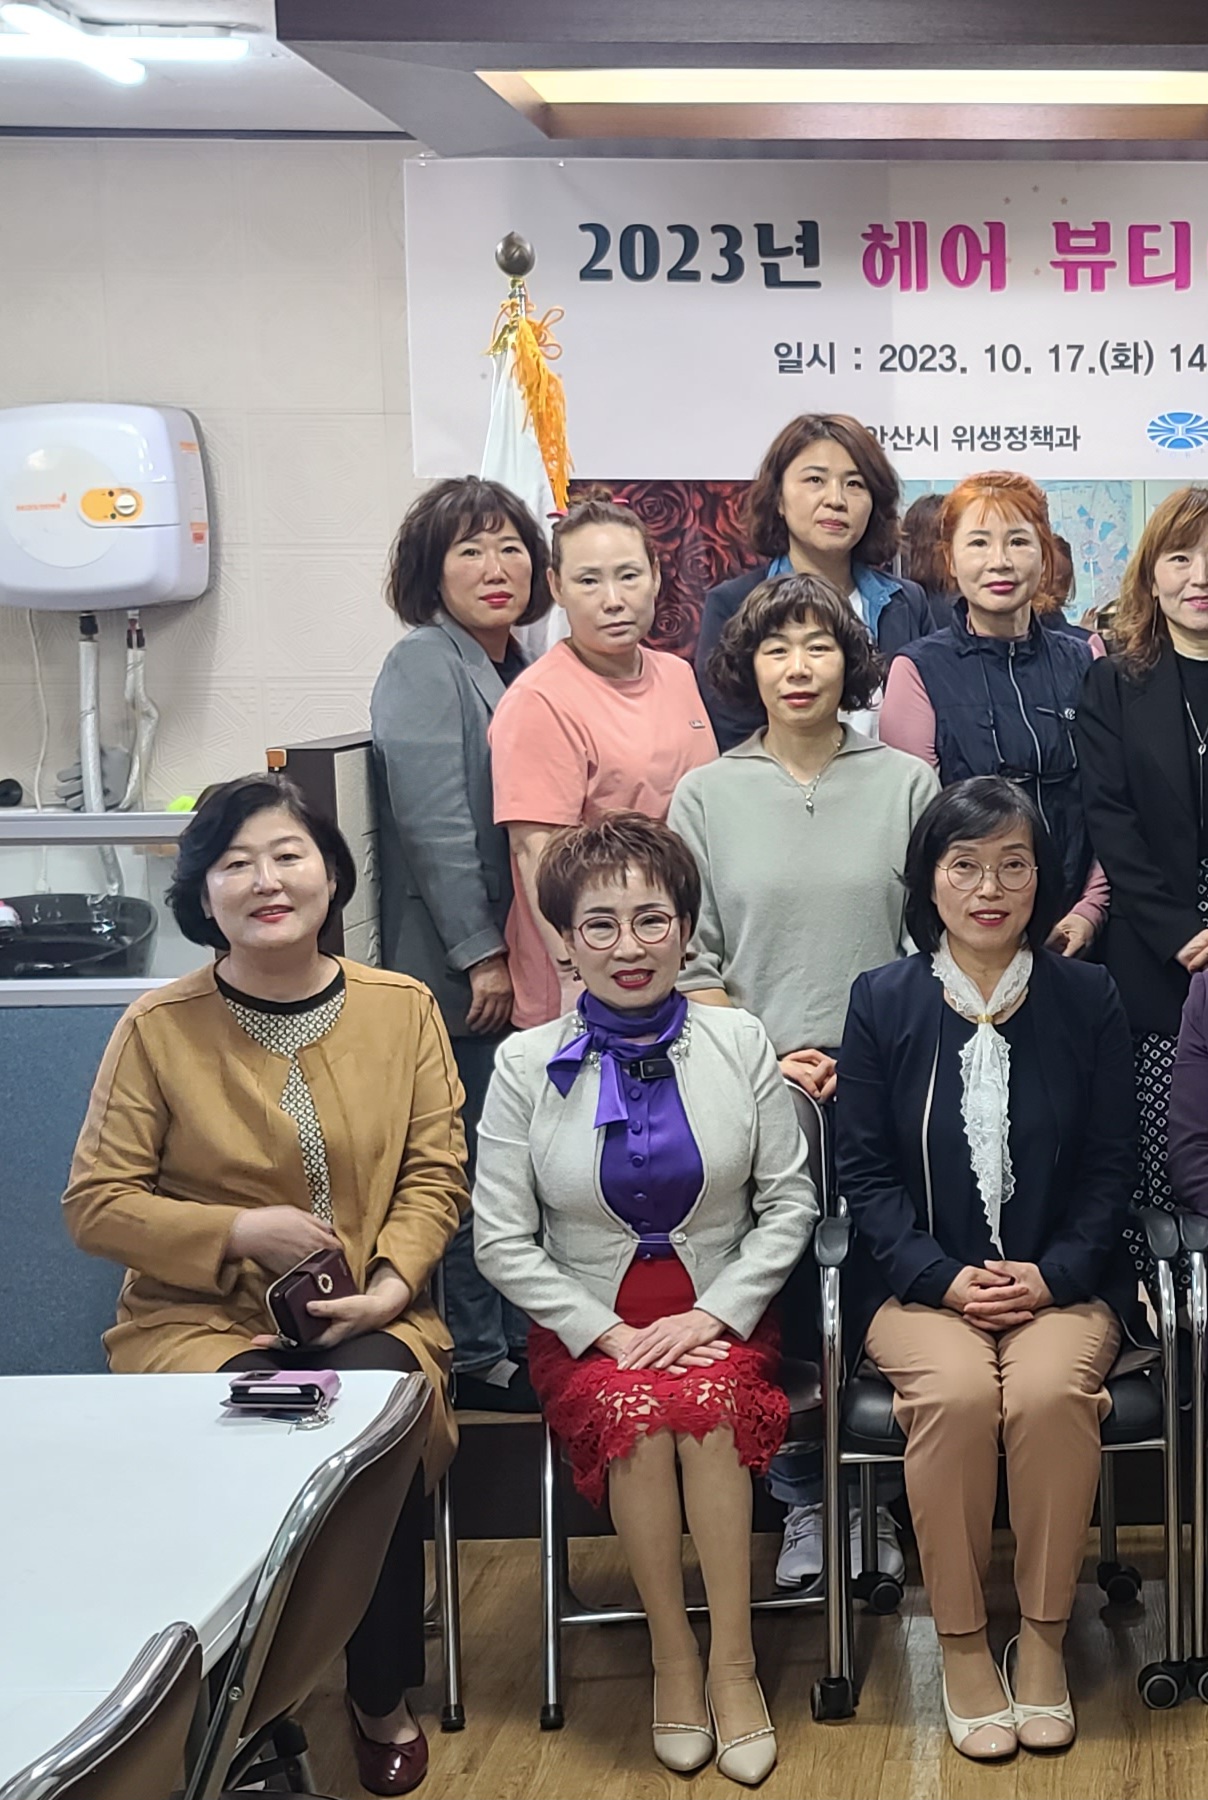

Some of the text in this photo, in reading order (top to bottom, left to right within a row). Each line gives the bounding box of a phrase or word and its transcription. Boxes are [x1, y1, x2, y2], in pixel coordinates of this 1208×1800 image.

[578, 220, 822, 289] 2023년
[861, 221, 1007, 292] 헤어
[774, 341, 836, 375] 일시
[879, 343, 968, 375] 2023.
[985, 343, 1032, 375] 10.
[1049, 340, 1154, 376] 17.(화)
[951, 425, 1081, 452] 위생정책과
